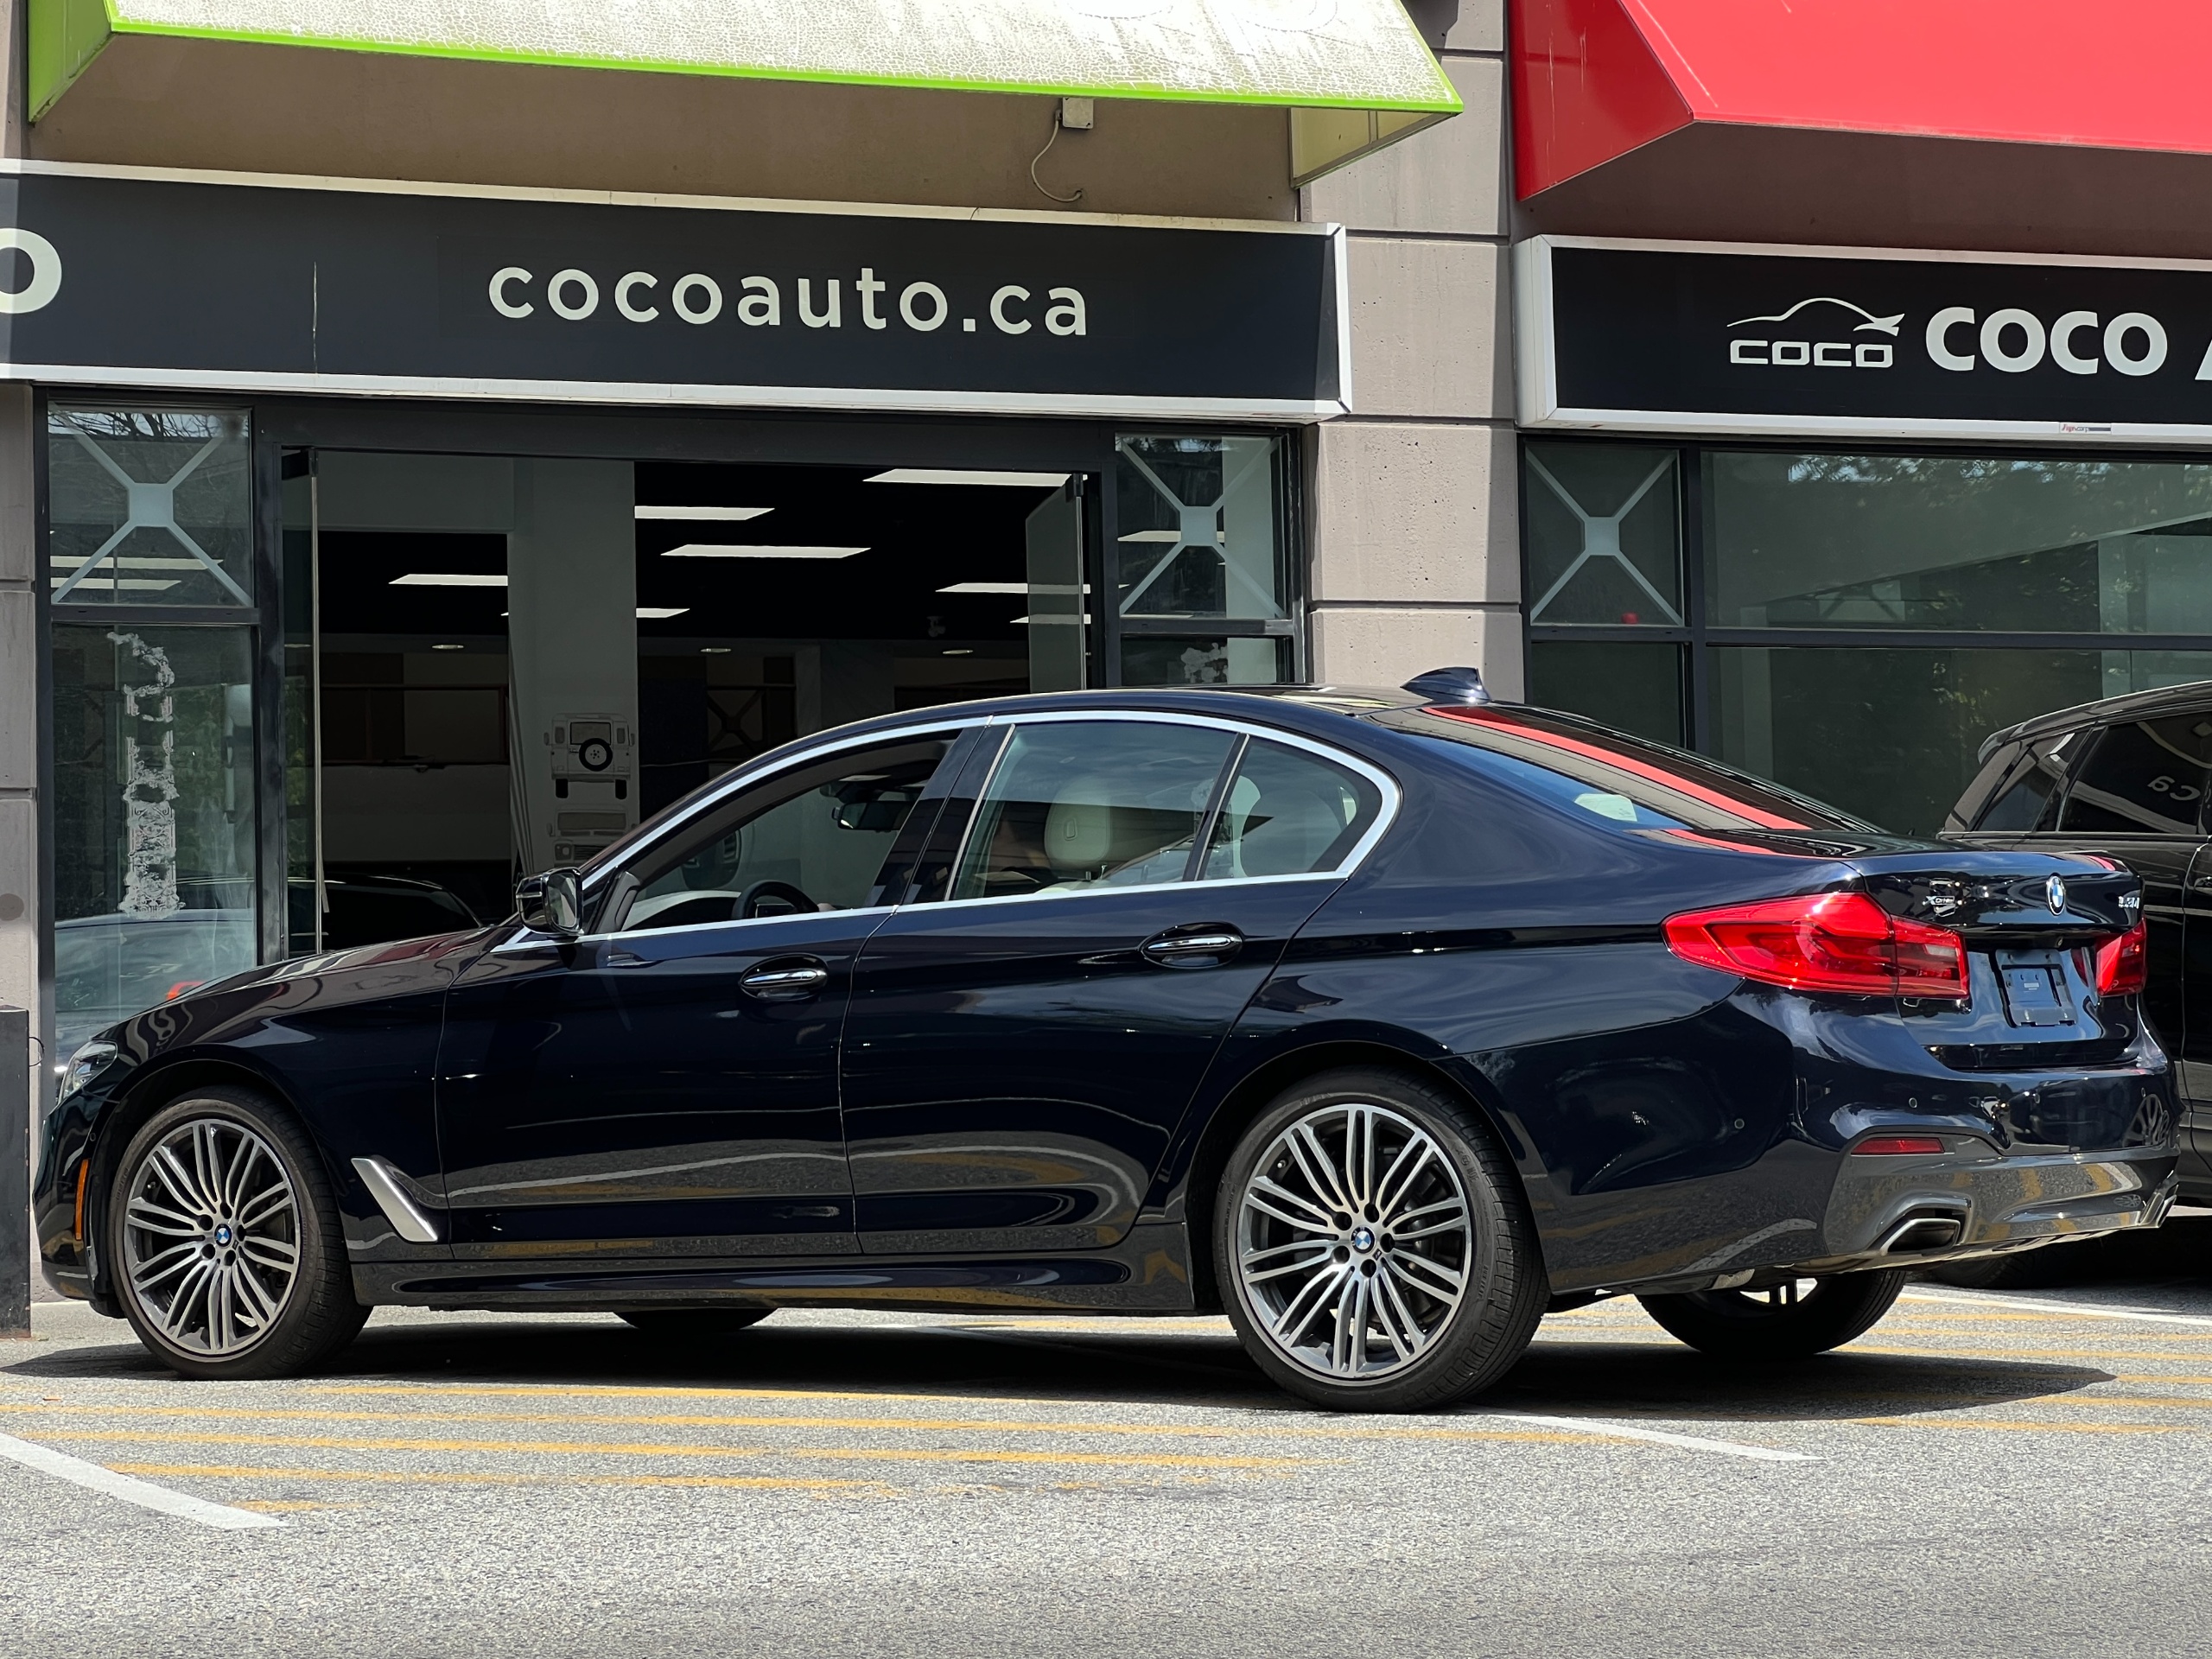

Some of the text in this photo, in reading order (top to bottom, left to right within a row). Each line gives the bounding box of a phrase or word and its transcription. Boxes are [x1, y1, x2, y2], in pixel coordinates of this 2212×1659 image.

[489, 267, 1086, 336] cocoauto.ca
[1730, 340, 1893, 369] COCO
[1925, 306, 2168, 377] COCO
